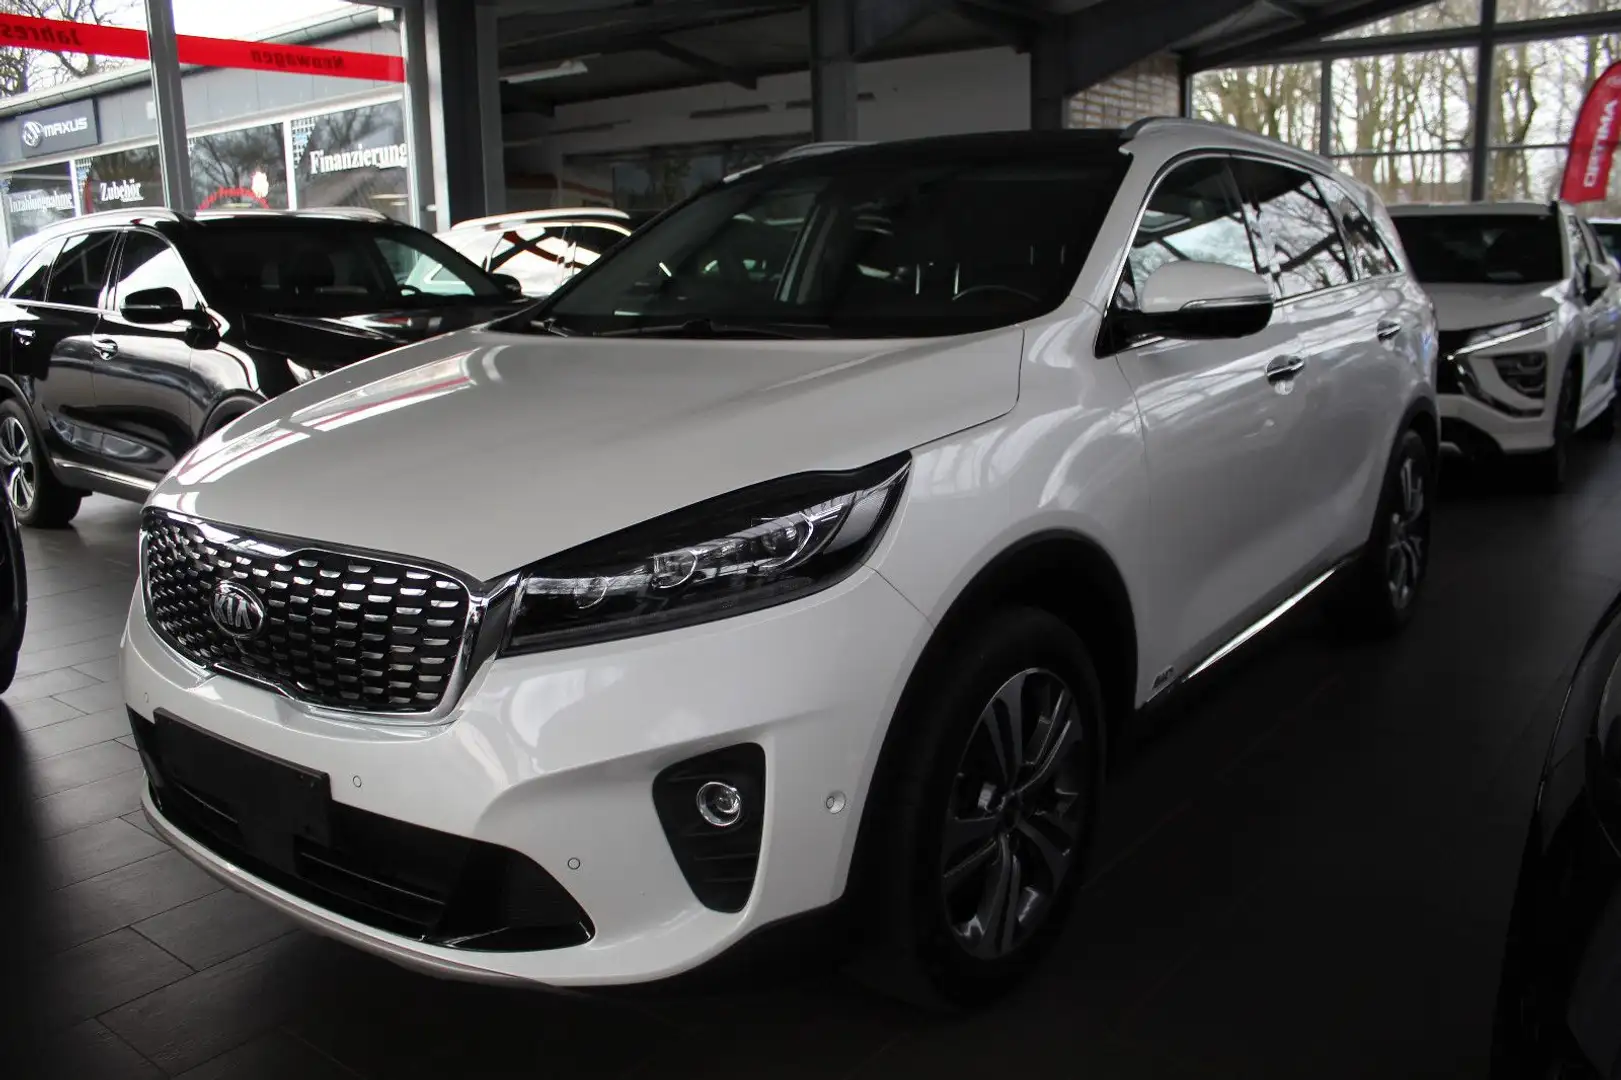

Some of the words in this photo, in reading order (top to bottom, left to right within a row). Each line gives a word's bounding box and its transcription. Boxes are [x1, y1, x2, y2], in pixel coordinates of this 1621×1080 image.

[43, 117, 88, 137] MAXUS
[310, 143, 407, 174] Finanzierung
[100, 178, 144, 202] Zubehör
[214, 592, 252, 629] KIA
